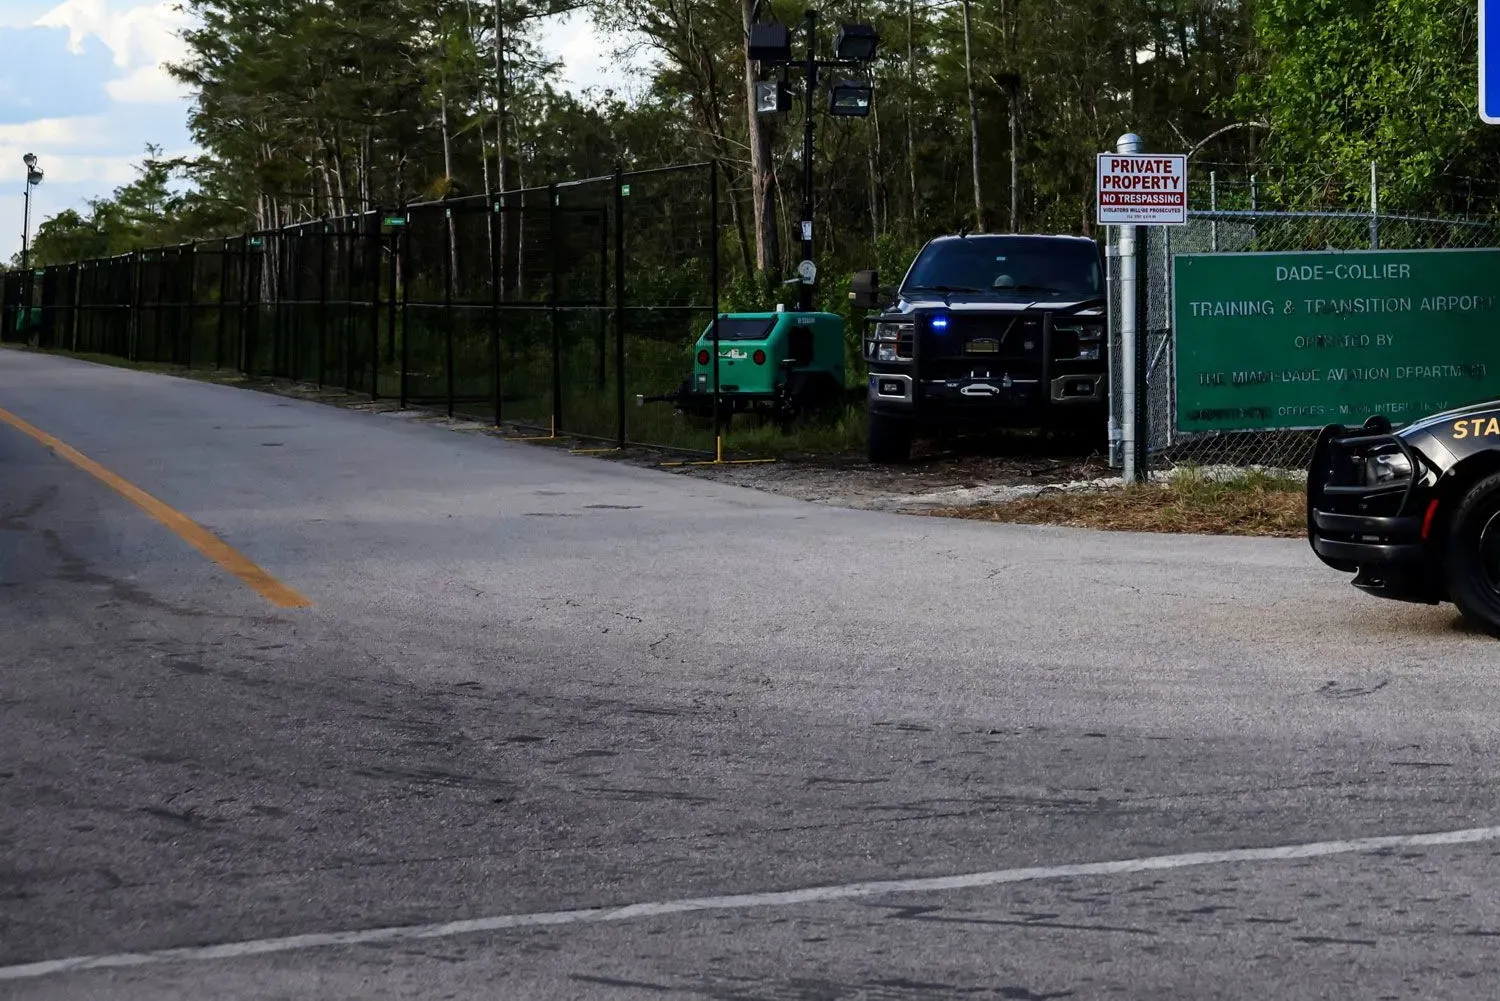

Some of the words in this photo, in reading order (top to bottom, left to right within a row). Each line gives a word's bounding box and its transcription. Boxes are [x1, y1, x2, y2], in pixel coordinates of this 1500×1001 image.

[1111, 159, 1172, 173] PRIVATE
[1102, 175, 1180, 189] PROPERTY
[1102, 194, 1116, 203] NO
[1118, 194, 1181, 204] TRESPASSING
[1276, 263, 1411, 281] DADE-COLLIER
[1189, 301, 1275, 317] TRAINING
[1283, 301, 1294, 314] &
[1376, 334, 1394, 346] BY
[1198, 372, 1225, 385] THE
[1396, 364, 1488, 379] DEPARTMT
